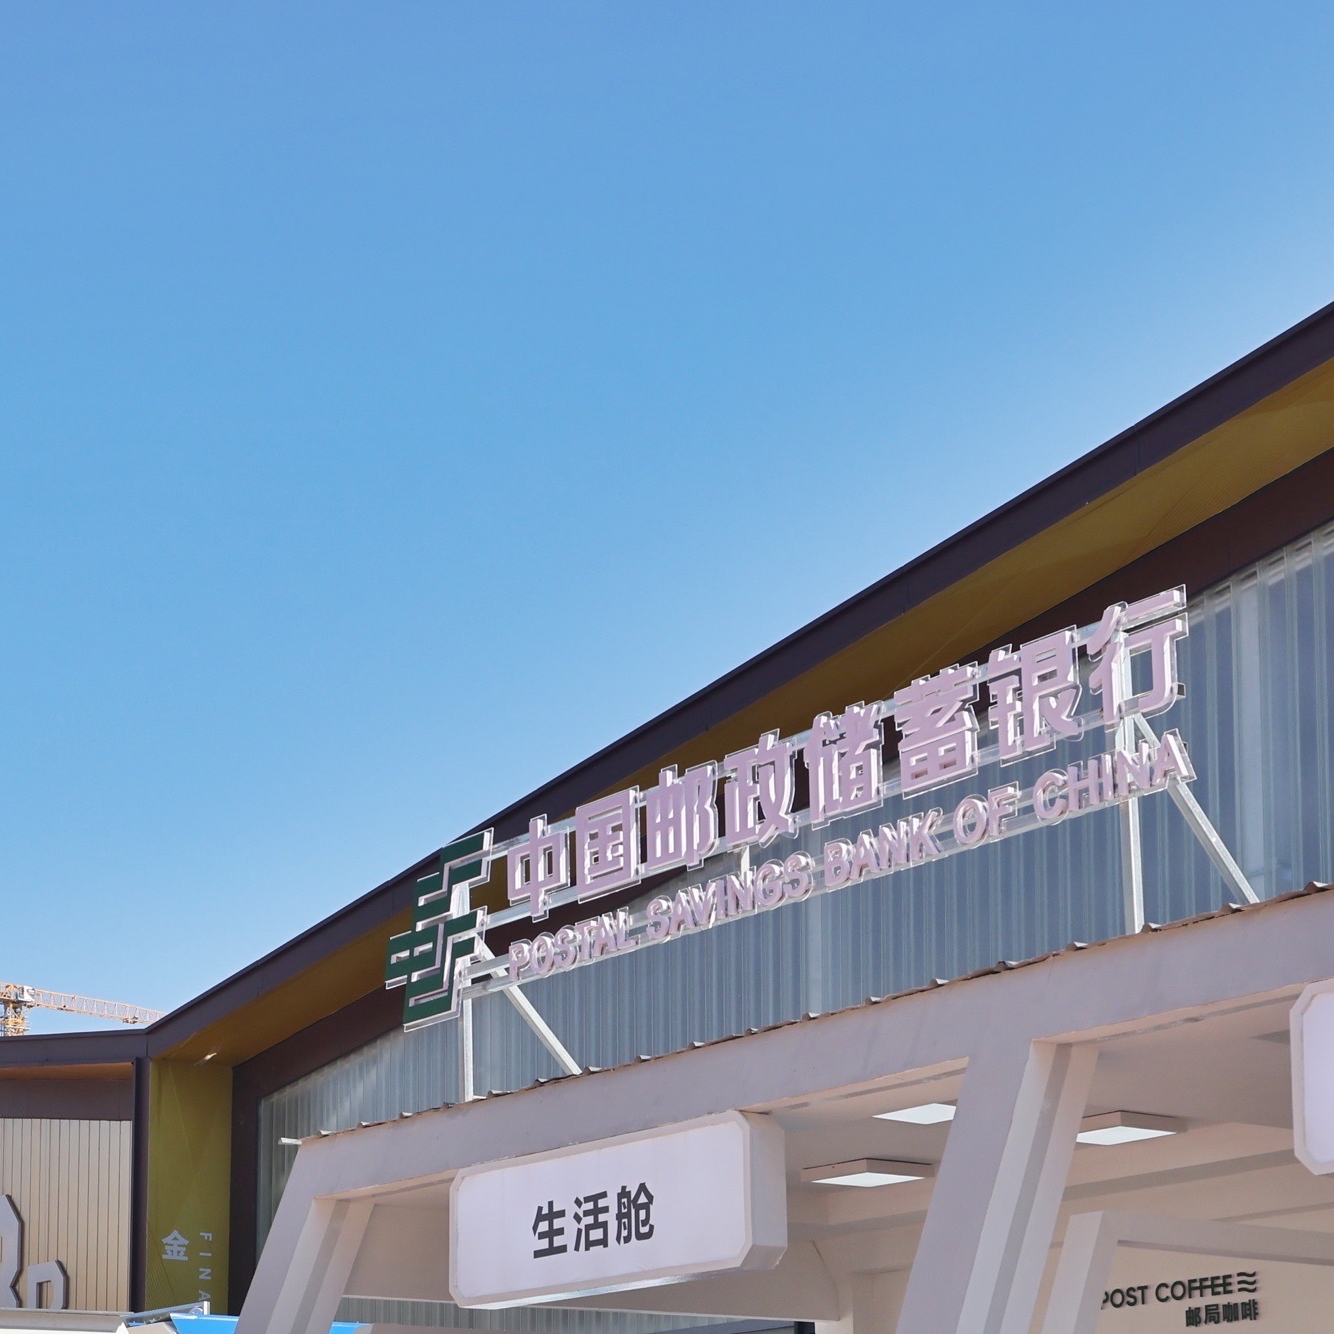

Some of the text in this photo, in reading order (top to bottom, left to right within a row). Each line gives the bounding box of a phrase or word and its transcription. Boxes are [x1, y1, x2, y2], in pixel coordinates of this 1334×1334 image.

[507, 585, 1189, 919] 中国邮政储蓄银行
[509, 730, 1197, 981] POSTAL SAVINGS BANK OF CHINA
[161, 1230, 189, 1261] 金
[532, 1182, 654, 1259] 生活舱
[1156, 1274, 1233, 1302] COFFEE
[1186, 1300, 1259, 1327] 邮局咖啡
